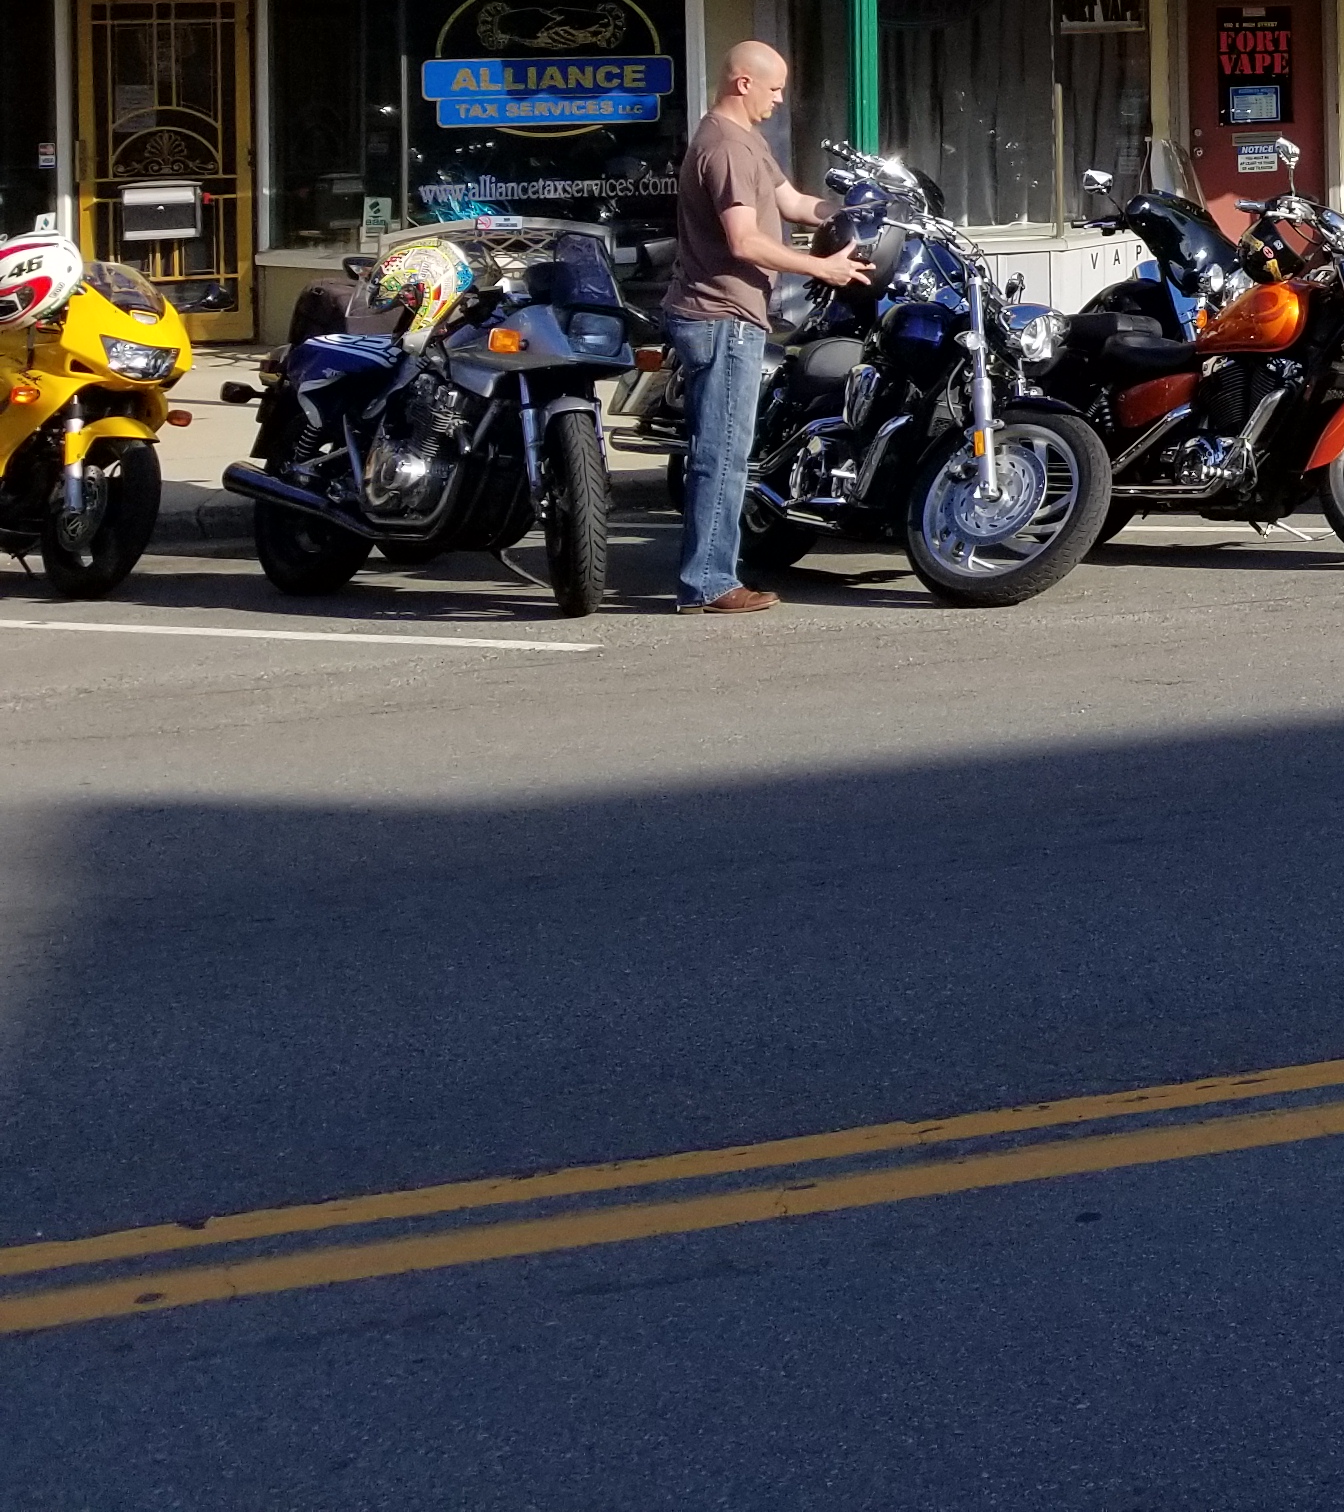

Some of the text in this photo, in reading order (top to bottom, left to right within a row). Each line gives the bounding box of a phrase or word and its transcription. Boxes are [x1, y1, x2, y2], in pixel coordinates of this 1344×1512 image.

[1219, 30, 1291, 53] FORT
[1219, 53, 1290, 75] VAPE
[451, 64, 647, 91] ALLIANCE
[455, 100, 644, 119] TAX SERVICES LLC
[1241, 144, 1275, 154] NOTICE
[7, 254, 44, 280] 46
